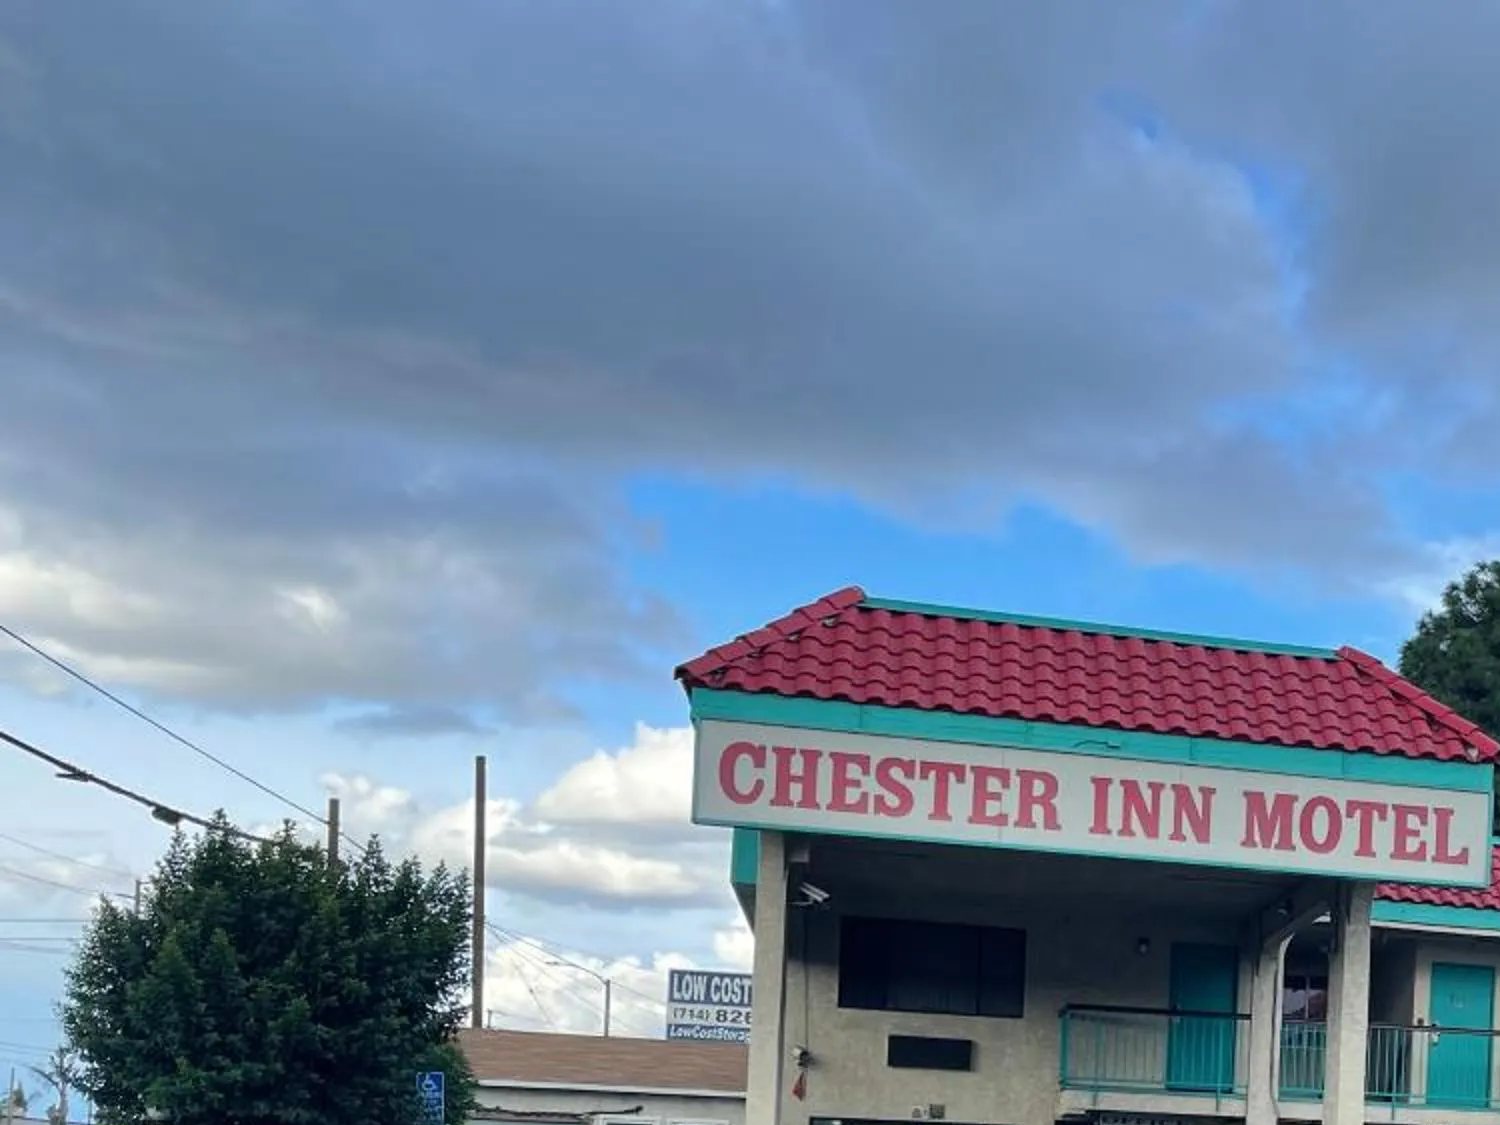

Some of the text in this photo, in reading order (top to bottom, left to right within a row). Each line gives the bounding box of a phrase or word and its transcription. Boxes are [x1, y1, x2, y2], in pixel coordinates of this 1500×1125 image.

[718, 741, 1470, 866] CHESTER INN MOTEL
[673, 973, 752, 1005] LOW COST
